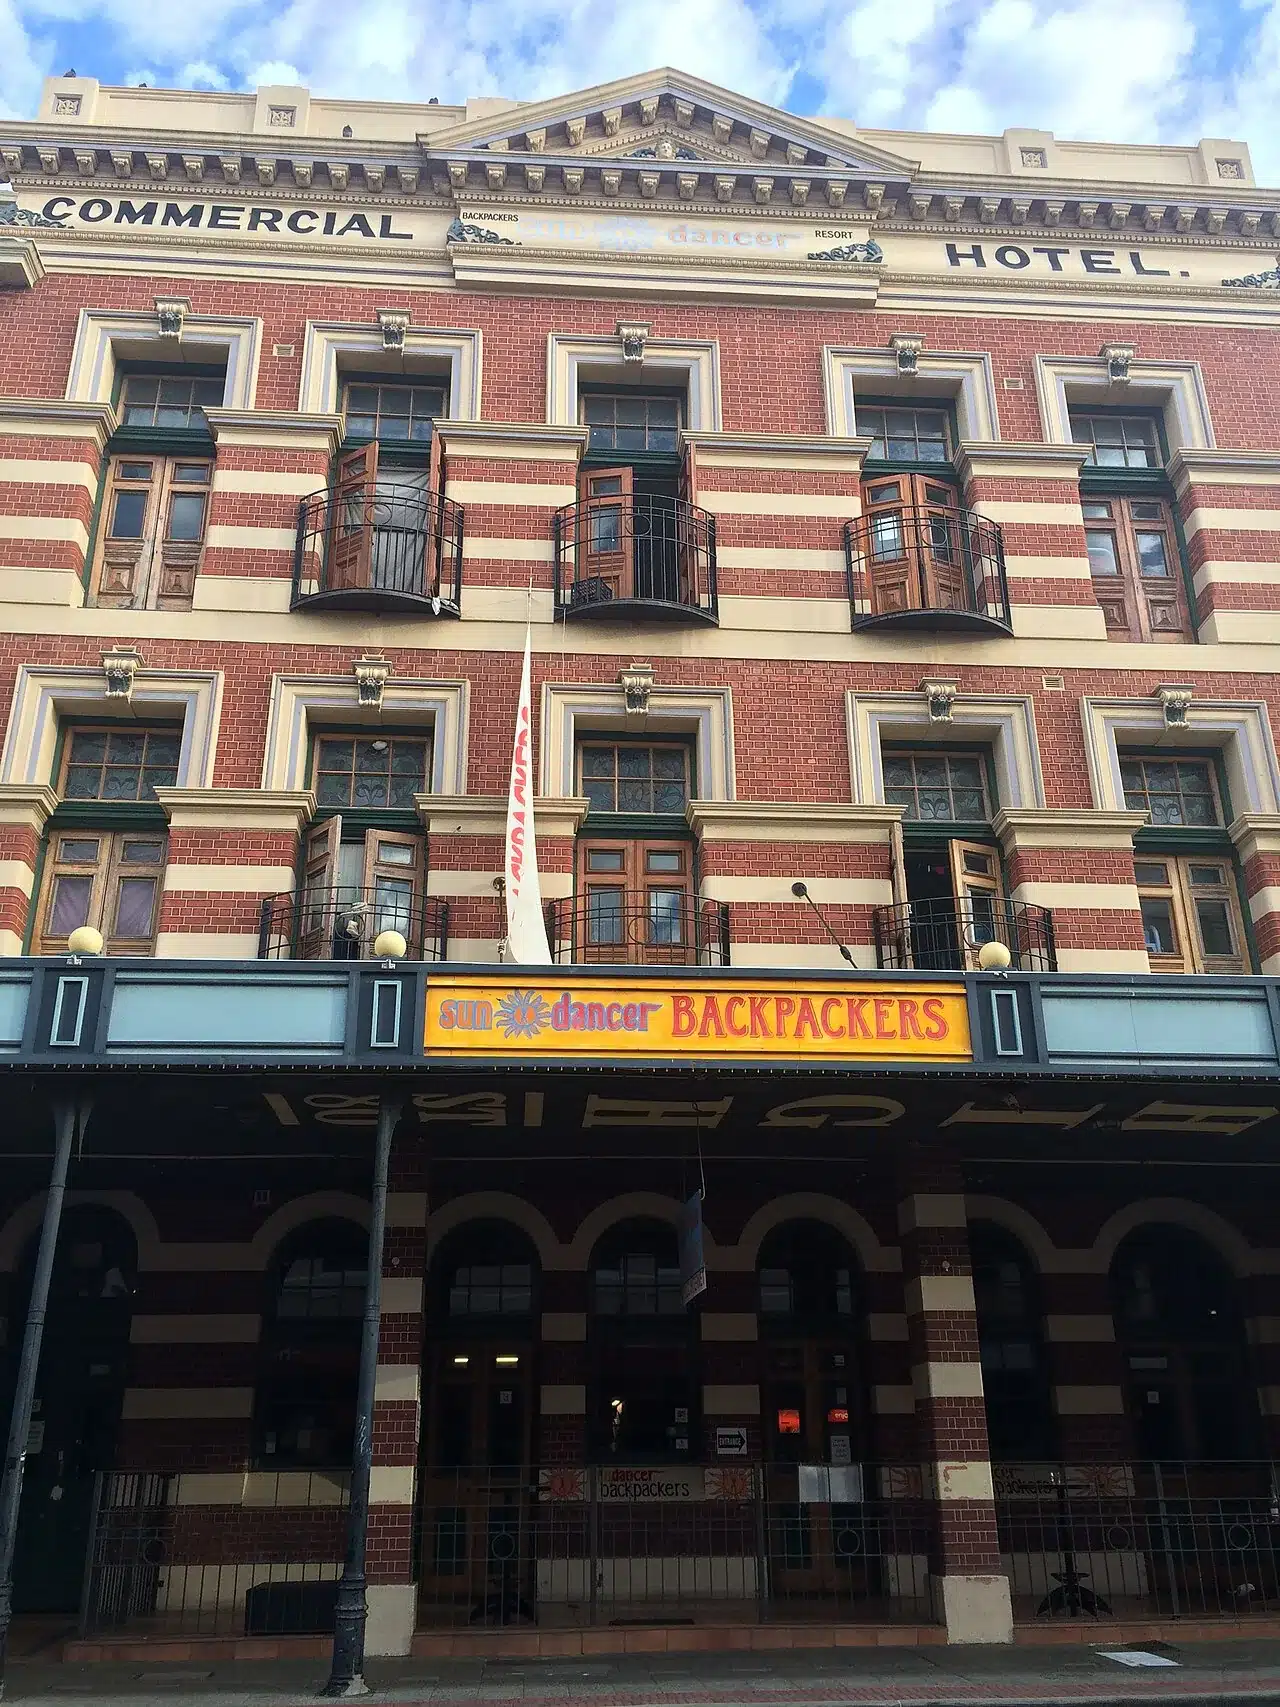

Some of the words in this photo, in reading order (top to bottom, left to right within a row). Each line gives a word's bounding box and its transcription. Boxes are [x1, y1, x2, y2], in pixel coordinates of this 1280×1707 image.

[43, 196, 414, 240] COMMERCIAL
[462, 211, 519, 223] BACKPACKERS
[814, 229, 853, 240] RESORT
[438, 998, 493, 1032] sun
[549, 992, 662, 1033] dancer
[670, 994, 950, 1042] BACKPACKERS
[583, 1094, 1280, 1135] HIGH
[719, 1437, 742, 1447] ENTRANCE
[612, 1468, 660, 1481] dancer
[600, 1481, 690, 1501] backpackers
